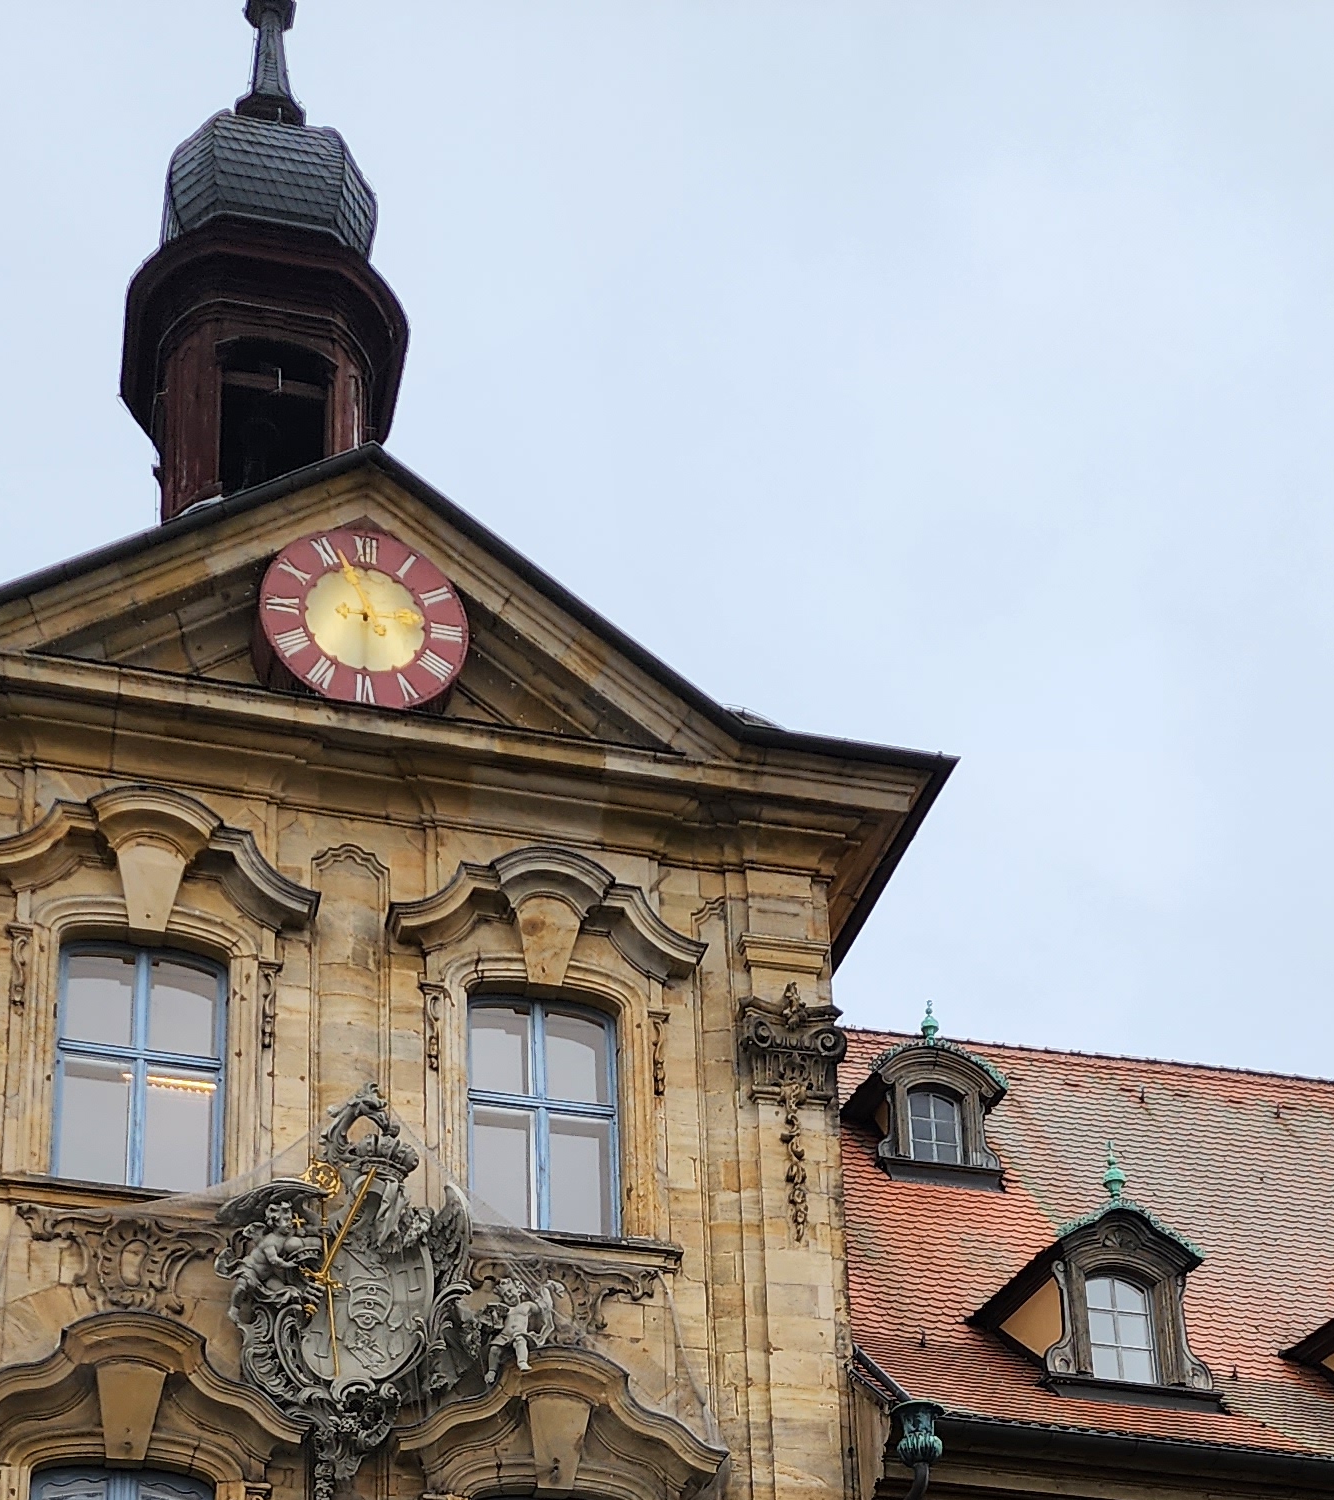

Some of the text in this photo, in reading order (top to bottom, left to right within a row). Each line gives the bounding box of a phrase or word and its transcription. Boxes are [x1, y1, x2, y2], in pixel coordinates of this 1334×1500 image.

[310, 536, 340, 567] XI
[352, 535, 378, 565] XII
[278, 557, 312, 586] X
[266, 593, 299, 616] IX
[419, 585, 453, 608] II
[273, 626, 311, 658] VIII
[430, 621, 463, 644] III
[305, 655, 336, 690] VII
